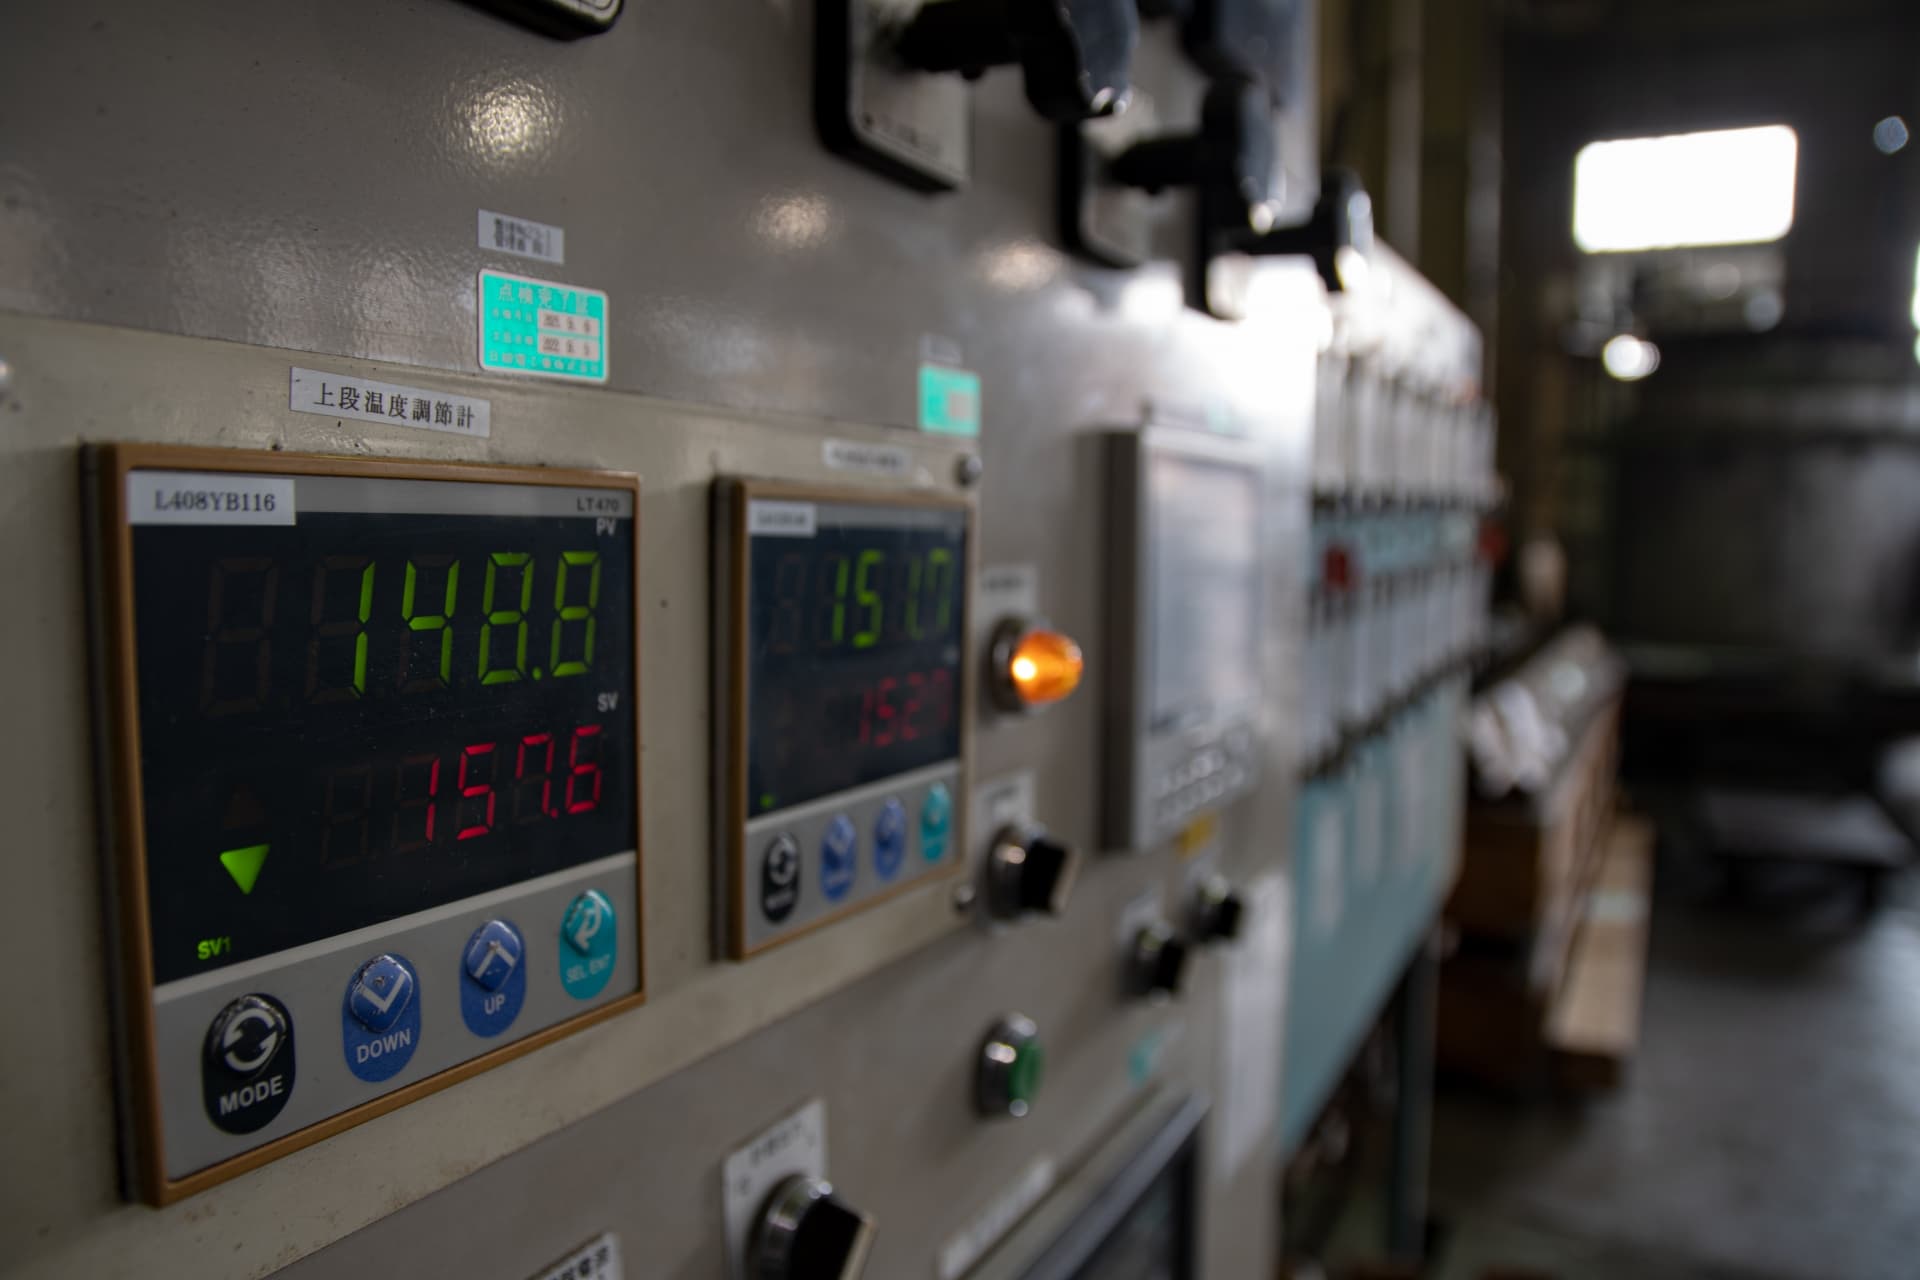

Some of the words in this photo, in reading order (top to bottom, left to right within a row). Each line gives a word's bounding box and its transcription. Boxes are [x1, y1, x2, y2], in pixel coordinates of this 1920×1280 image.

[313, 382, 476, 430] 上段温度調節計
[155, 490, 276, 512] L408YB116
[576, 495, 620, 513] LT470
[595, 517, 617, 537] PV
[351, 550, 600, 699] 148.8
[597, 692, 619, 712] SV
[425, 724, 602, 842] 157.6
[197, 936, 231, 960] SV1
[484, 995, 506, 1016] UP
[355, 1028, 412, 1064] DOWN
[219, 1074, 284, 1115] MODE
